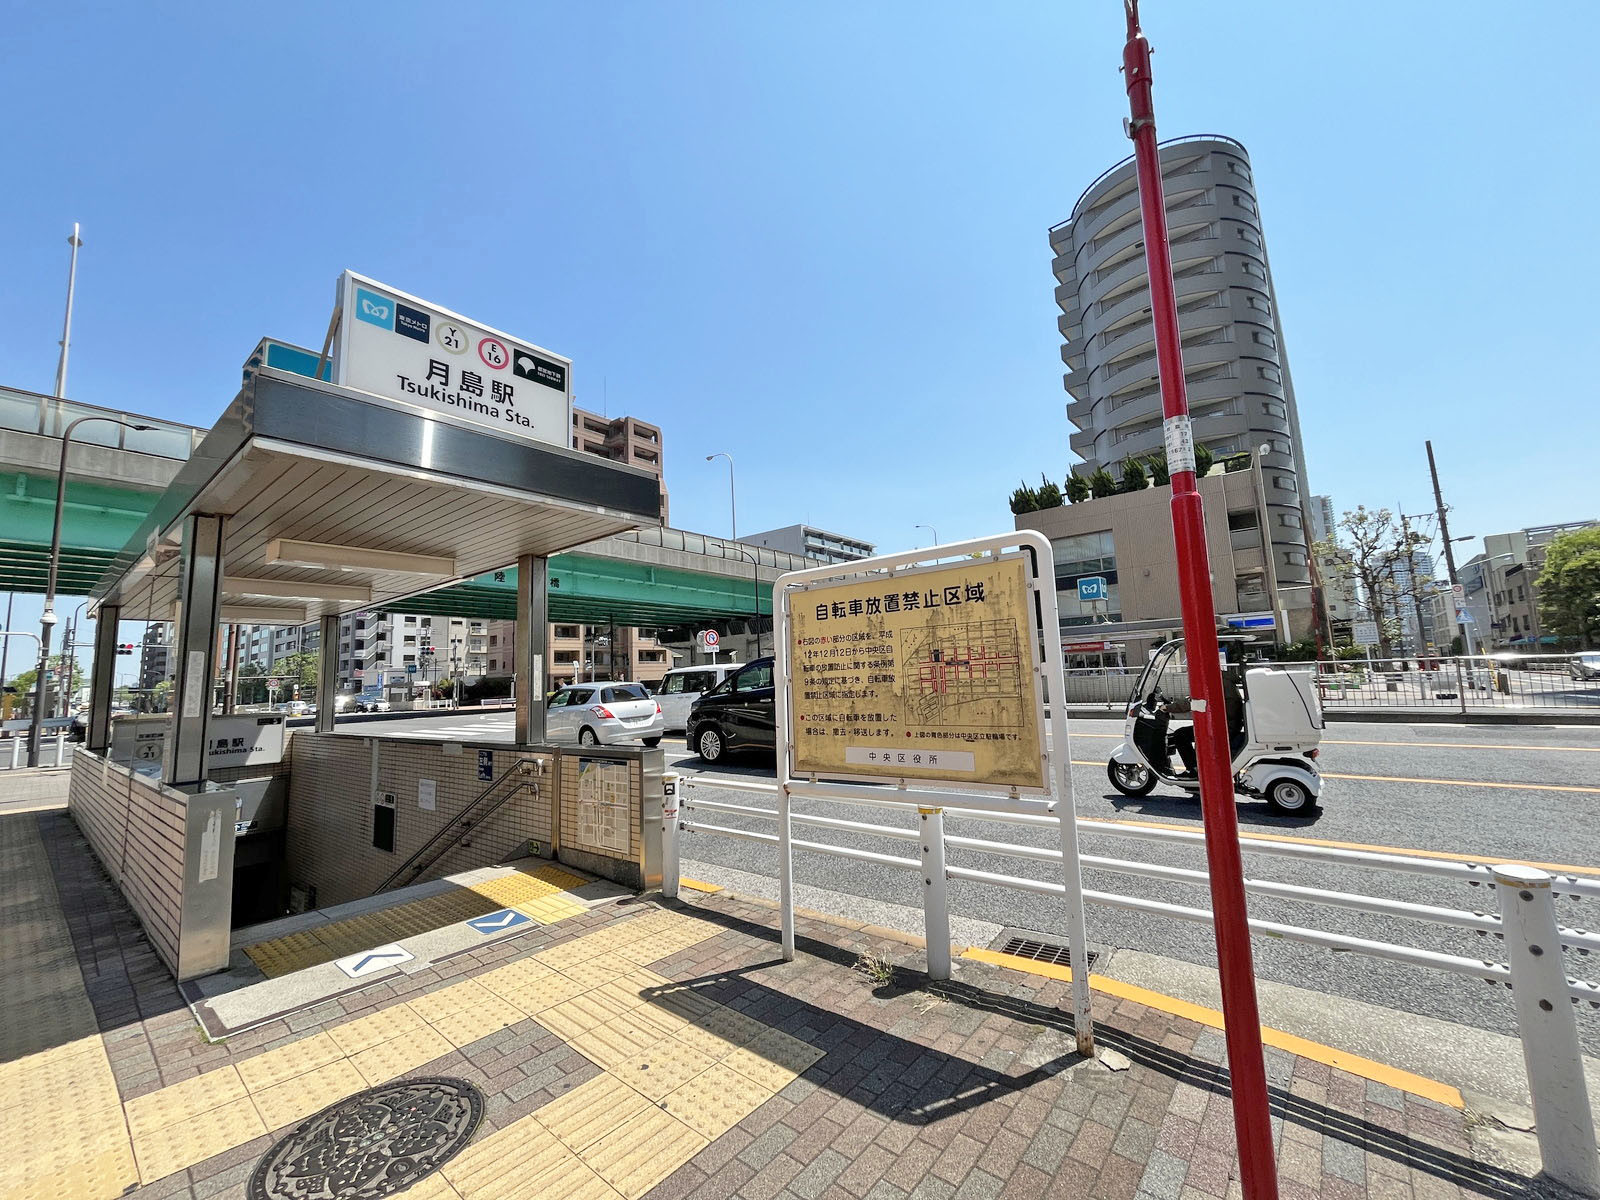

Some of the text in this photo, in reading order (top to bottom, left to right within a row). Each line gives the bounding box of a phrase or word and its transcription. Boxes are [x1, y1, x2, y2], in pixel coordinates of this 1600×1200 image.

[449, 327, 457, 337] Y
[444, 336, 460, 349] 21
[491, 343, 497, 353] E
[487, 351, 502, 364] 16
[425, 358, 514, 407] 月島駅
[397, 374, 535, 429] Tsukishima Sta.
[816, 582, 985, 621] 自転車放置禁止区域
[209, 737, 244, 750] 島駅
[208, 747, 247, 756] ukishima
[868, 752, 938, 765] 中央区役所
